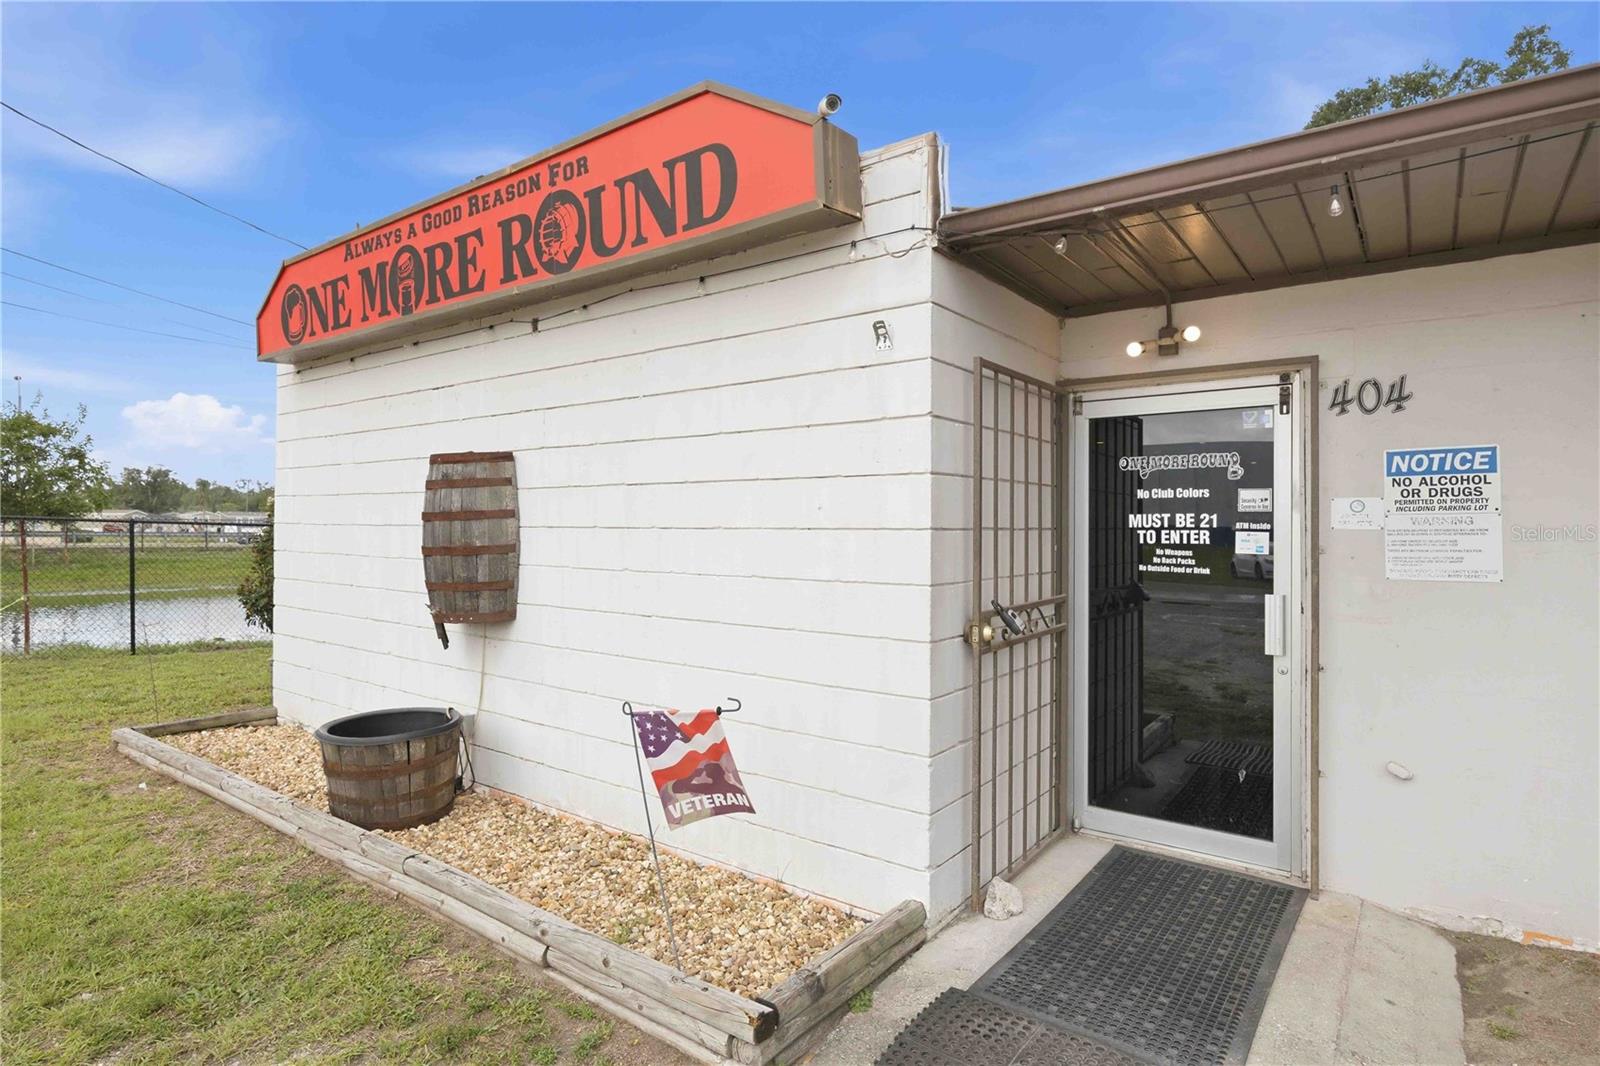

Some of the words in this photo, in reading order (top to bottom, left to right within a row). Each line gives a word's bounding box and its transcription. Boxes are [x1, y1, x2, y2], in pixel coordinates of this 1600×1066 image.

[344, 227, 402, 262] ALWAYS
[407, 222, 417, 240] A
[422, 204, 462, 233] GOOD
[468, 172, 541, 217] REASON
[547, 155, 589, 187] FOR
[281, 274, 352, 346] ONE
[358, 227, 486, 322] MORE
[497, 142, 738, 284] ROUND
[1328, 374, 1413, 416] 404
[1119, 456, 1149, 478] ONE
[1149, 454, 1188, 470] MORE
[1188, 452, 1242, 474] ROUND
[1391, 451, 1492, 473] NOTICE
[1392, 477, 1412, 487] NO
[1418, 475, 1492, 487] ALCOHOL
[1137, 488, 1150, 499] No
[1151, 488, 1174, 498] Club
[1176, 487, 1210, 498] Colors
[1400, 488, 1421, 498] OR
[1428, 486, 1483, 498] DRUGS
[1128, 513, 1171, 528] MUST
[1175, 513, 1195, 528] BE
[1199, 513, 1217, 528] 21
[1410, 515, 1474, 526] WARNING
[1137, 530, 1156, 544] TO
[1160, 530, 1210, 544] ENTER
[1164, 548, 1193, 556] Weapons
[1147, 565, 1170, 573] Outside
[1193, 567, 1210, 575] Drink
[667, 793, 750, 819] VETERAN
